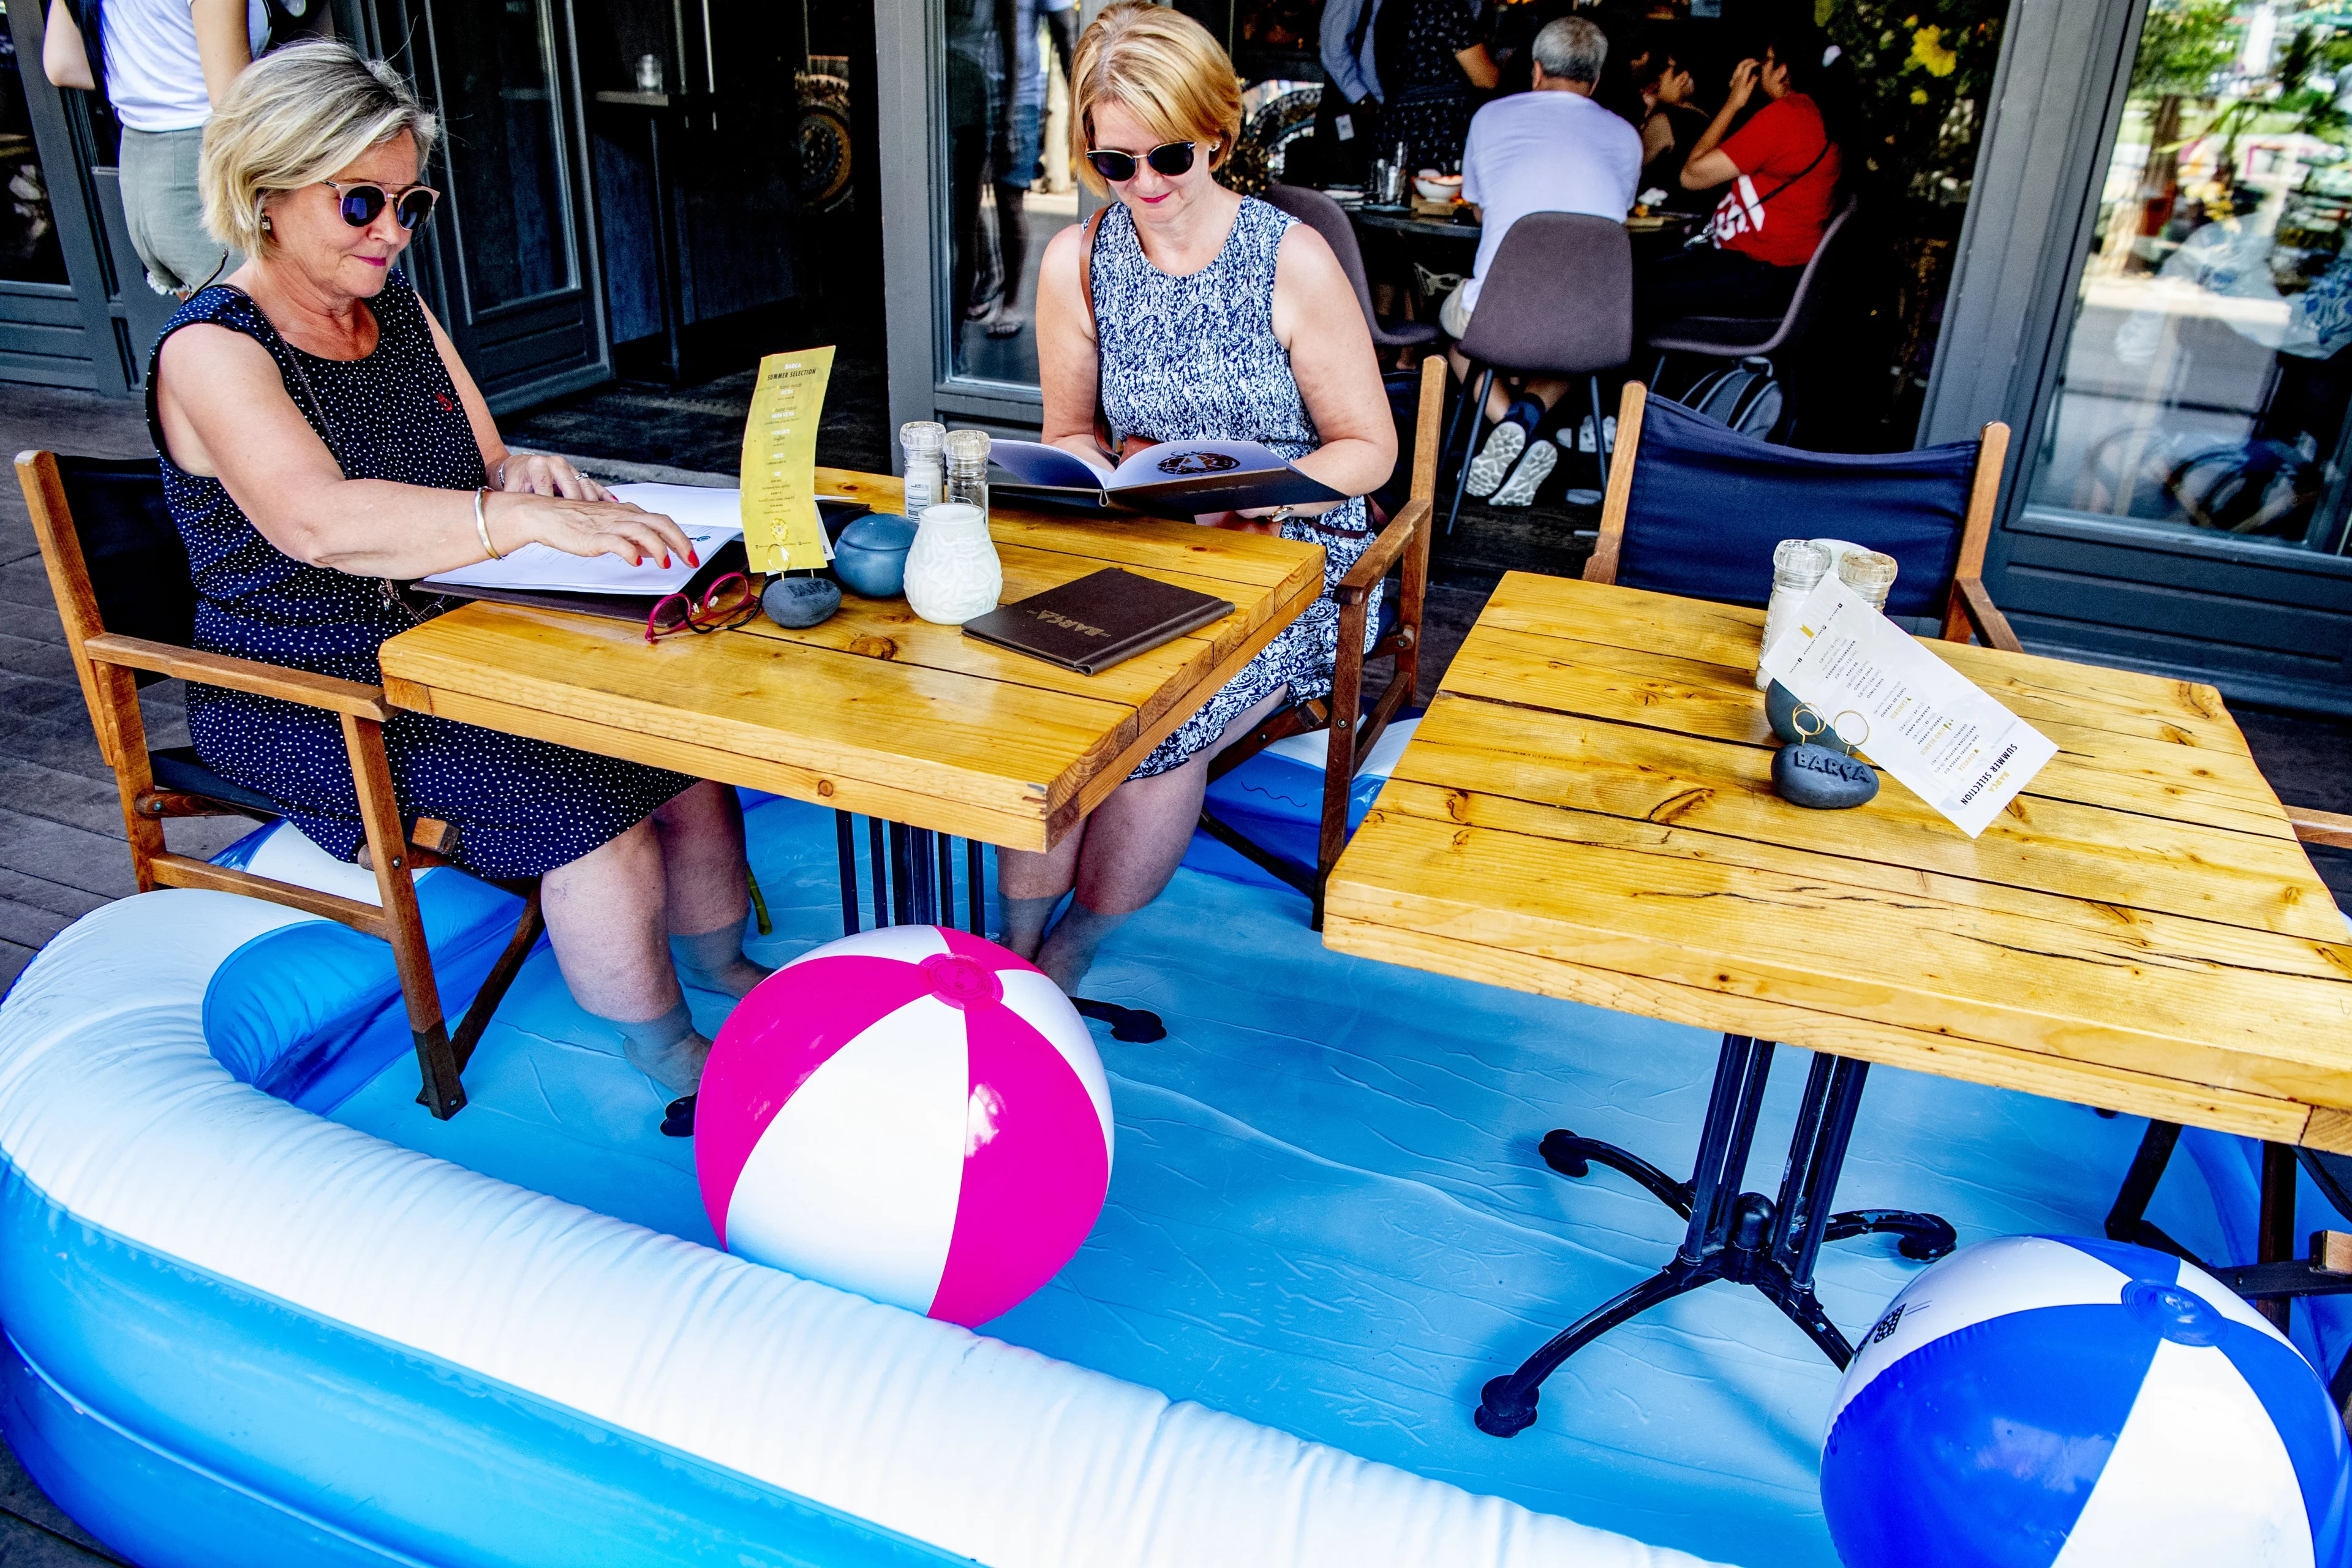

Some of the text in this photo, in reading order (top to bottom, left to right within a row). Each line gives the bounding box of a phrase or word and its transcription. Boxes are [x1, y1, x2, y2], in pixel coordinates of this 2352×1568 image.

[767, 368, 816, 380] SUMMER SELECTION
[1825, 639, 1856, 679] WATERMELON SANGRIA
[1845, 666, 1854, 676] CAVA
[1853, 666, 1873, 690] VINO BLANCO
[1866, 677, 1883, 698] VINO TINTO
[1896, 687, 1906, 698] TINTO
[1880, 703, 1893, 717] VERANO
[1889, 699, 1907, 720] SANGRIA
[1904, 723, 1916, 736] AMBAR
[1929, 715, 1943, 731] VERDEJO
[1953, 723, 1967, 739] OEDIPUS
[1919, 726, 1945, 756] VINO BLANCO
[1957, 725, 1976, 746] BARCELONA
[1943, 745, 1958, 762] TROPICAL
[1959, 742, 1972, 755] MIGUEL
[1794, 750, 1871, 782] BARÇA
[1949, 755, 1961, 767] FRESCA
[1957, 752, 1976, 772] CERVEZA
[1960, 743, 2018, 805] SUMMER SELECTION
[1986, 770, 2010, 794] BARÇA
